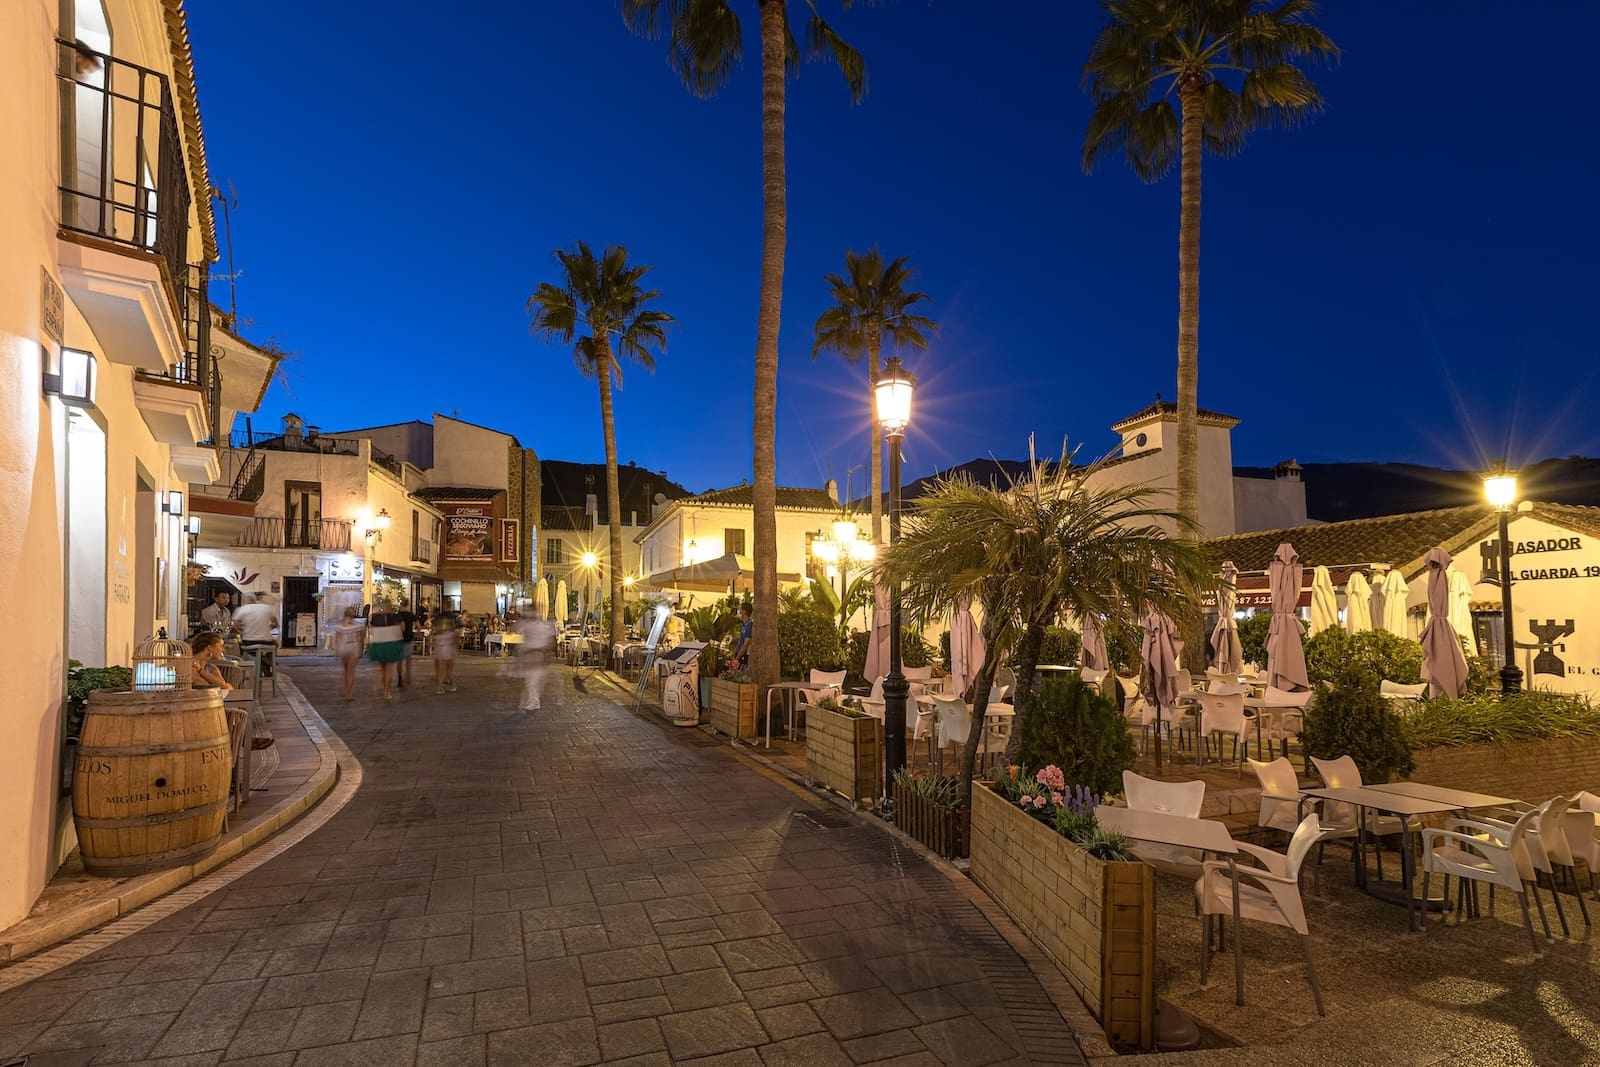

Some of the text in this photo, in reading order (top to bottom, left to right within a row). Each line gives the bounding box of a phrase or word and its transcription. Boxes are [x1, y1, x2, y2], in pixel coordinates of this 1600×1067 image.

[1515, 537, 1582, 554] ASADOR
[1520, 567, 1579, 580] GUARDA
[1568, 666, 1585, 675] EL
[105, 783, 208, 804] MIGUEL DOMECQ
